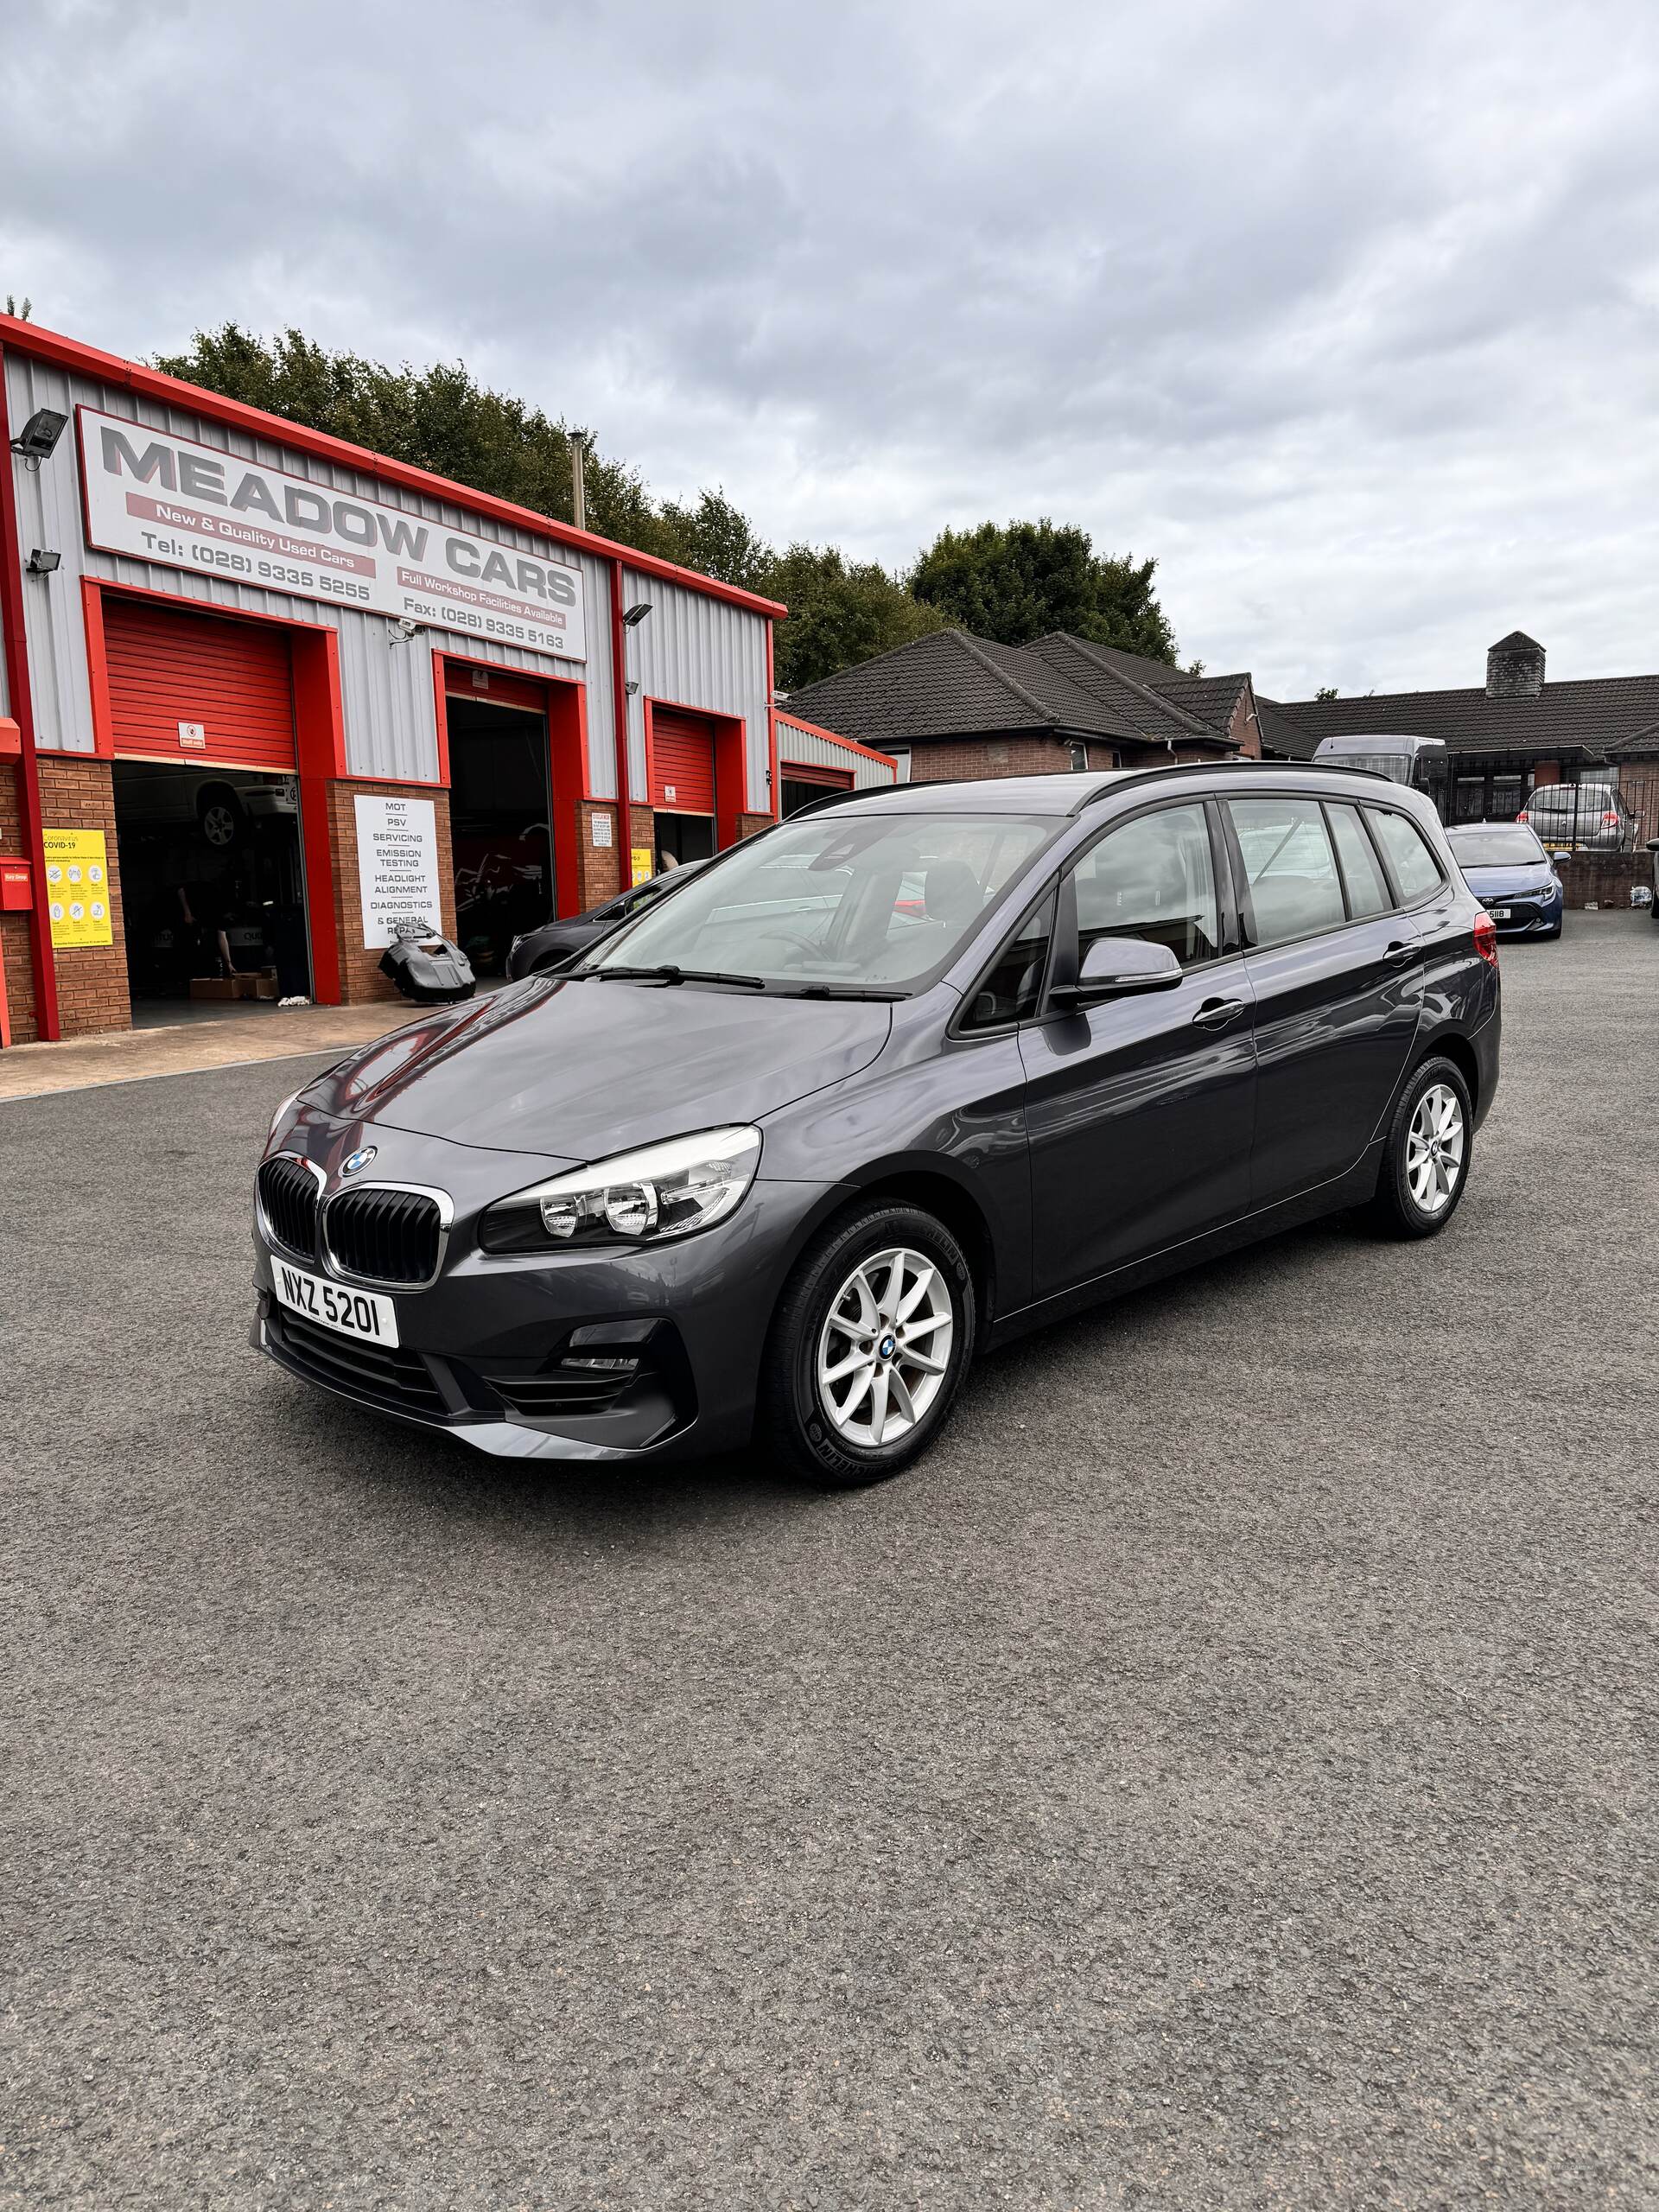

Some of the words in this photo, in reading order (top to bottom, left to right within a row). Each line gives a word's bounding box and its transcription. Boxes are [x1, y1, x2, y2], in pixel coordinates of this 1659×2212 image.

[100, 426, 429, 562] MEADOW
[445, 537, 576, 607] CARS
[156, 504, 196, 526] New
[201, 518, 214, 531] &
[219, 523, 275, 550] Quality
[278, 537, 316, 557] Used
[321, 550, 354, 568] Cars
[141, 531, 183, 556] Tel:
[192, 544, 252, 573] (028)
[258, 562, 314, 587] 9335
[320, 575, 370, 601] 5255
[402, 571, 422, 586] Full
[424, 576, 477, 601] Workshop
[480, 593, 522, 613] Facilities
[524, 606, 563, 625] Available
[404, 597, 435, 617] Fax:
[442, 607, 482, 628] (028)
[486, 619, 524, 639] 9335
[528, 629, 564, 649] 5163
[385, 802, 406, 810] MOT
[372, 833, 423, 842] SERVICING
[386, 916, 429, 925] GENERAL
[281, 1267, 320, 1316] NXZ
[322, 1286, 380, 1336] 5201
